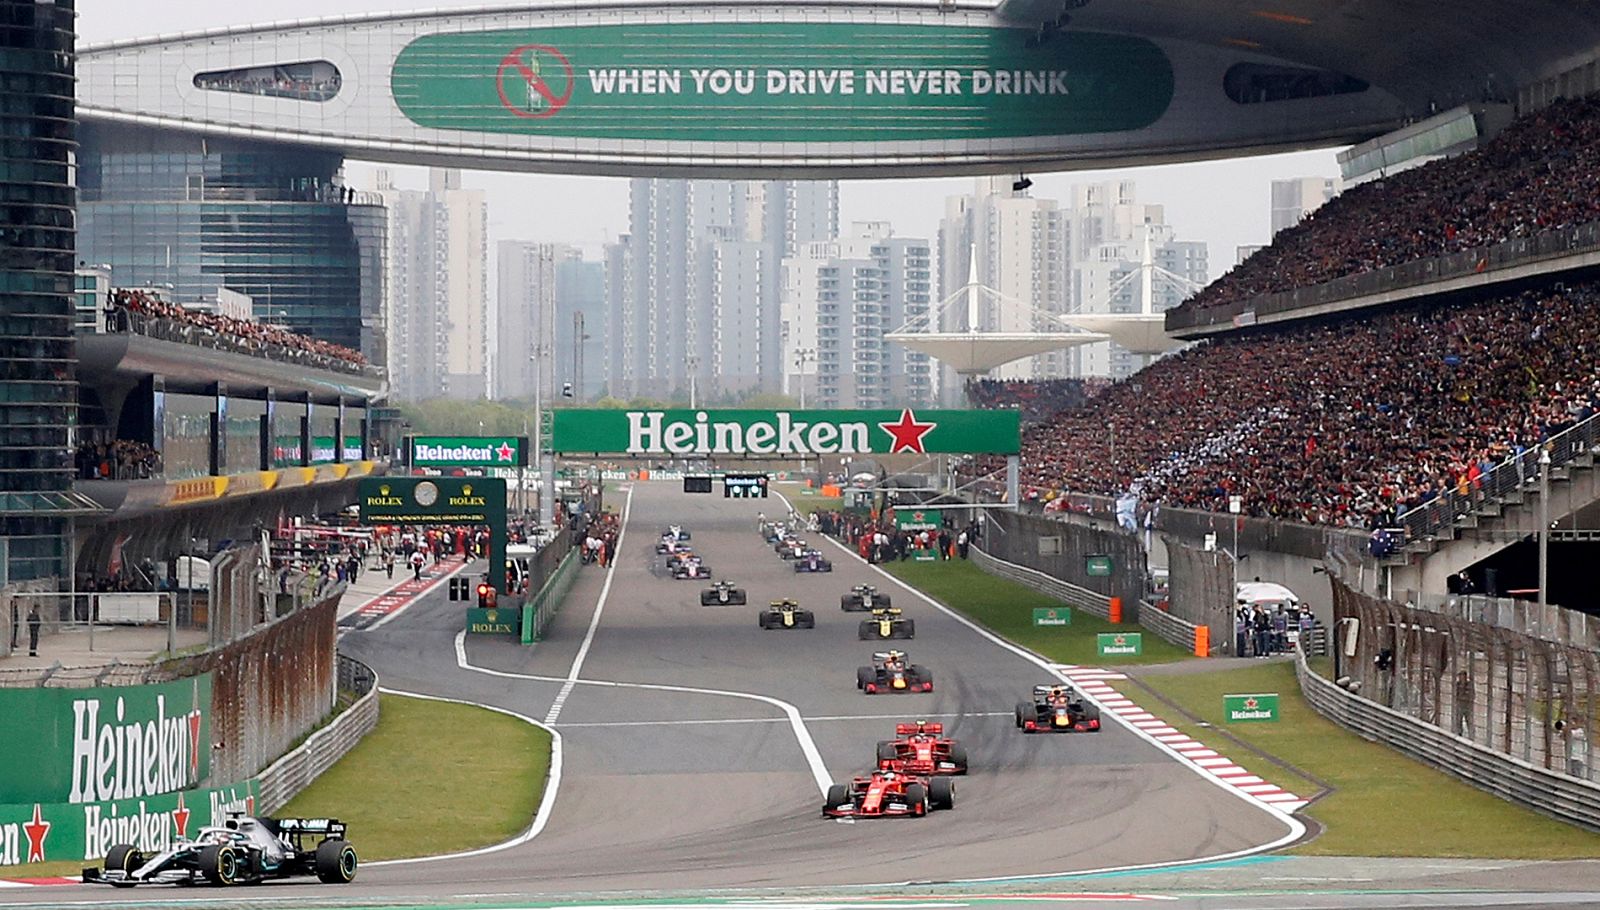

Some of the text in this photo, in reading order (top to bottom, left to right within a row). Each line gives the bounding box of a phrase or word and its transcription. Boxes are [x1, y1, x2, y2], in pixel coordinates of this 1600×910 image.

[588, 69, 1069, 95] WHEN YOU DRIVE NEVER DRINK
[626, 411, 872, 453] Heineken
[415, 444, 493, 461] Heineken
[367, 497, 403, 506] ROLEX
[449, 497, 485, 506] ROLEX
[472, 624, 512, 632] ROLEX
[69, 694, 187, 804] Heineken
[84, 800, 171, 860] Heineken
